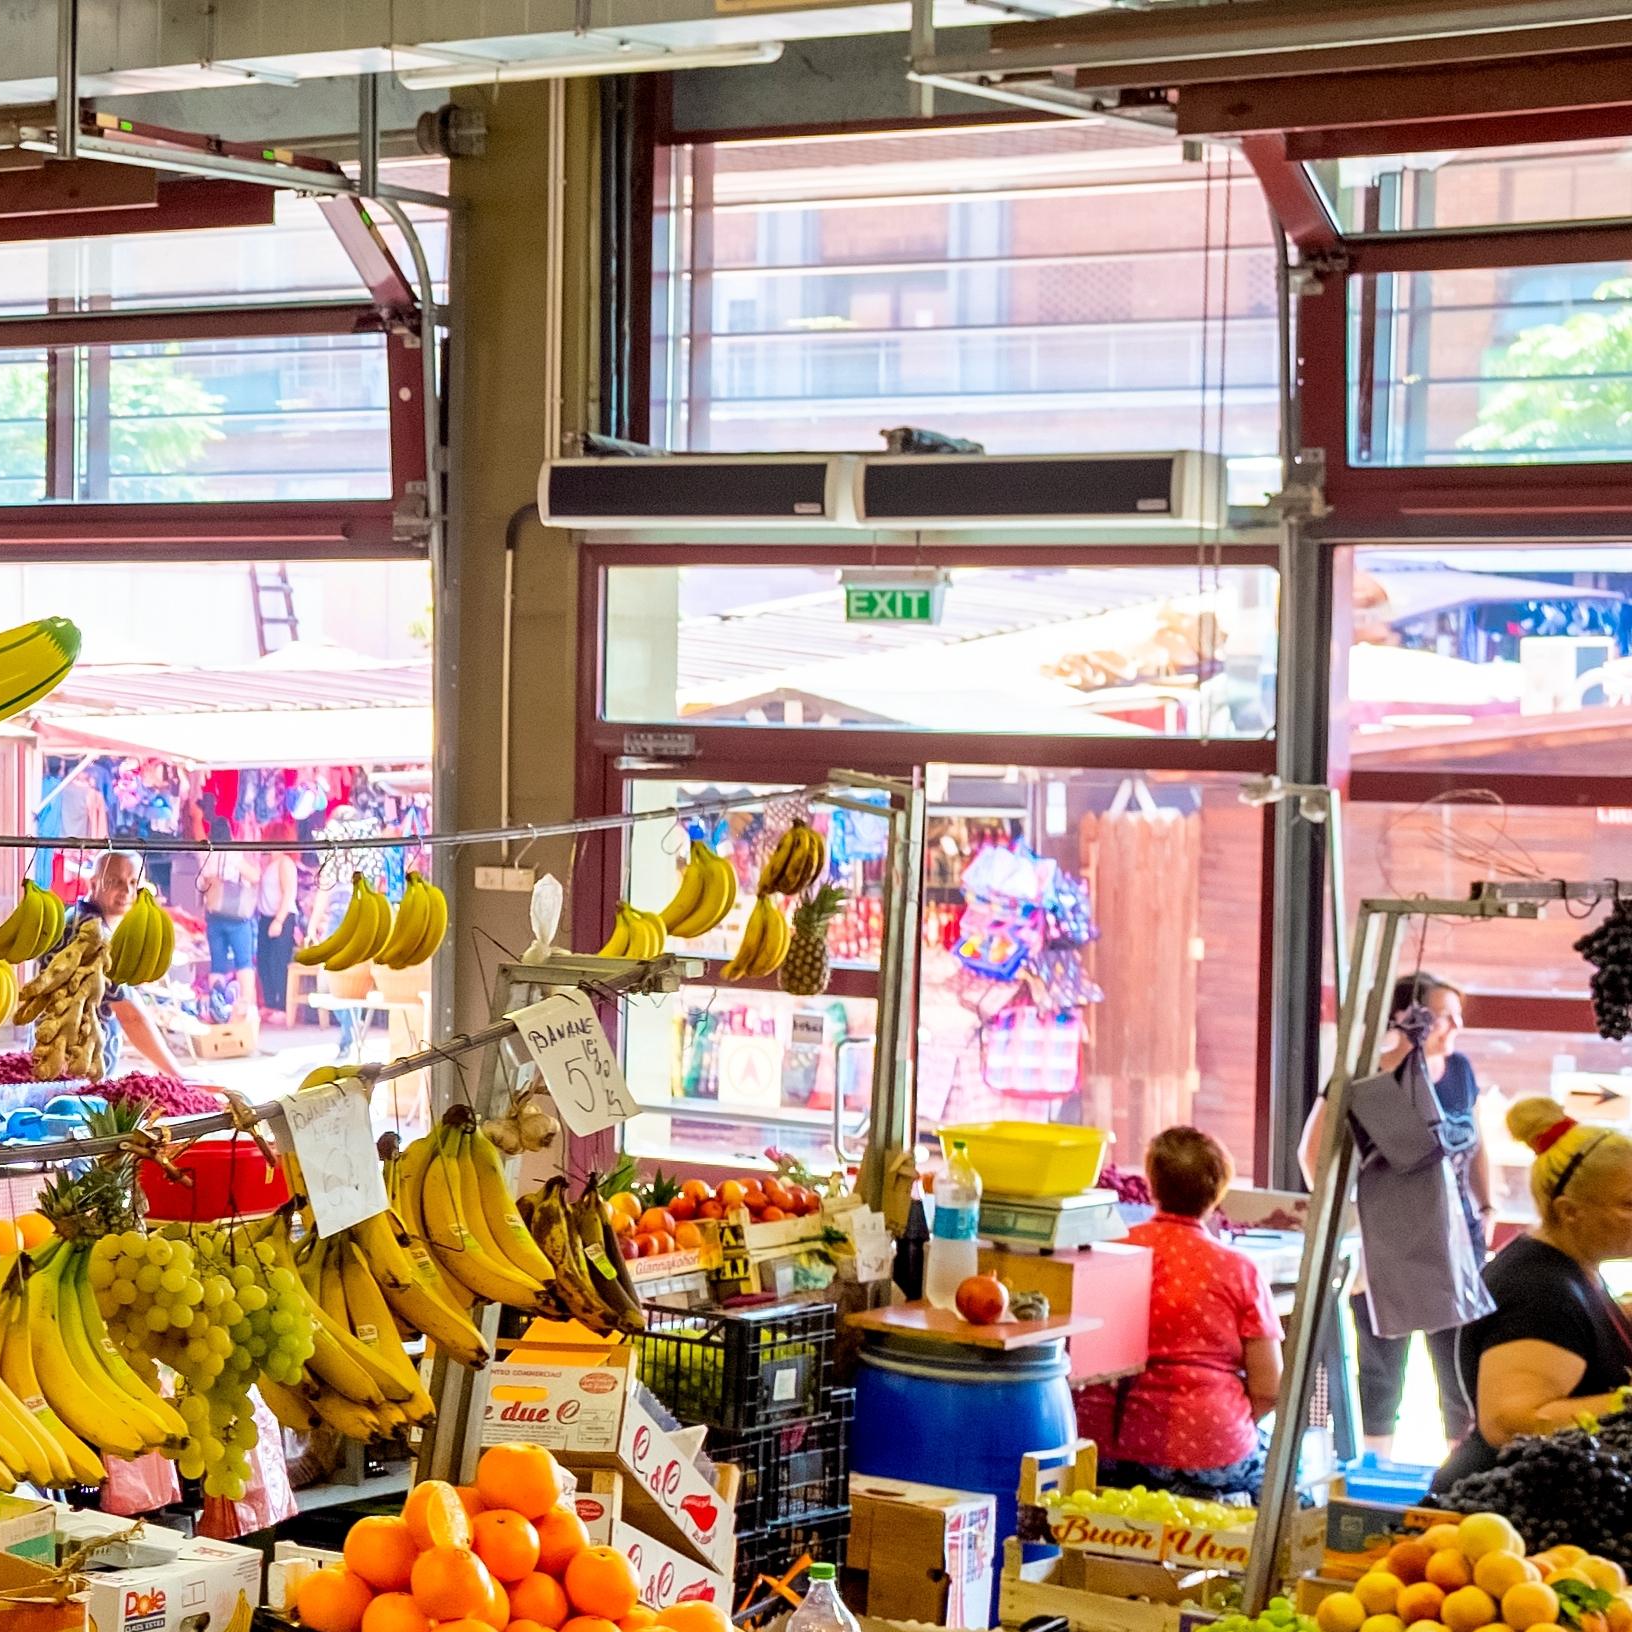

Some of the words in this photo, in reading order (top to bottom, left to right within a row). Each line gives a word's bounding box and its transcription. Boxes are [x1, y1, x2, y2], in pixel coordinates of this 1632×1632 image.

[847, 589, 928, 620] EXIT
[500, 1400, 551, 1423] due
[1051, 1513, 1157, 1550] Buon
[1166, 1527, 1251, 1564] Uva
[125, 1586, 167, 1618] Dole
